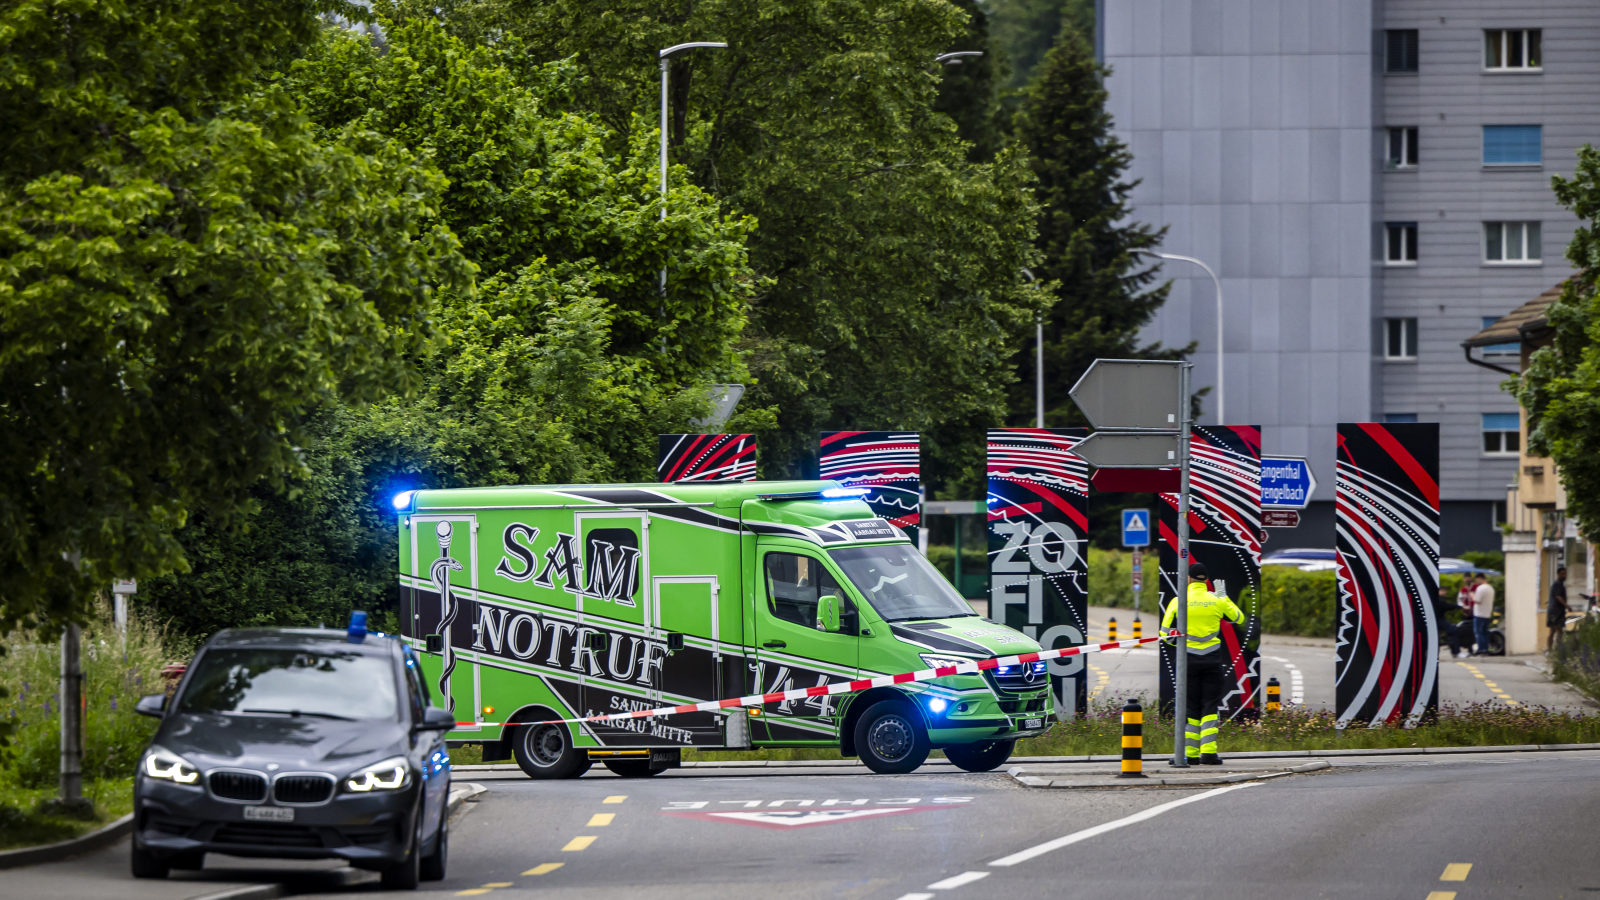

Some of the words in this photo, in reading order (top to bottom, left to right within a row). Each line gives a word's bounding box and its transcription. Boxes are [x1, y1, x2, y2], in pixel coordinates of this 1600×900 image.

[1261, 463, 1300, 483] angenthal
[1261, 484, 1304, 503] rengelbach
[495, 522, 641, 607] SAM
[991, 521, 1079, 573] ZO
[991, 574, 1043, 624] FI
[471, 605, 672, 686] NOTRUF
[748, 661, 837, 722] 144
[650, 724, 693, 744] MITTE
[660, 796, 975, 810] SCHULE
